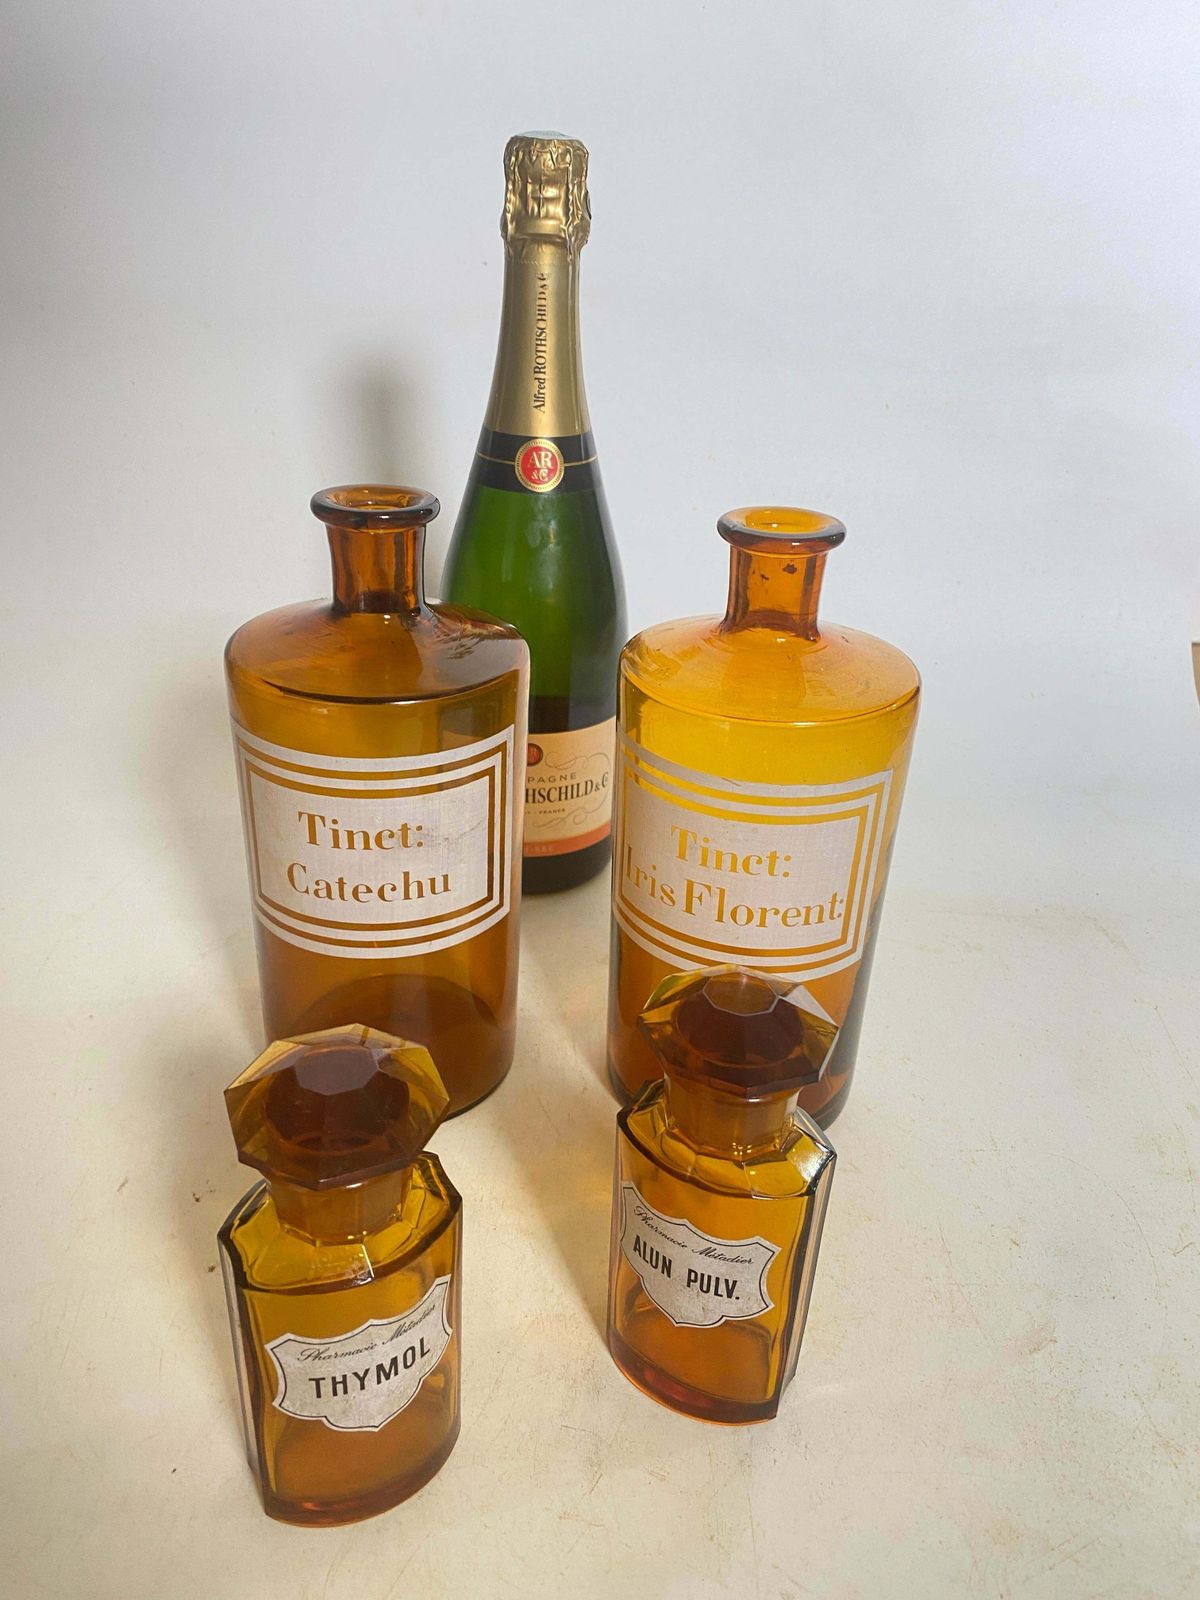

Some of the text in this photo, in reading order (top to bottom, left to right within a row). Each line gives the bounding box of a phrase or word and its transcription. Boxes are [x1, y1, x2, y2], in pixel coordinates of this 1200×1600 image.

[532, 377, 546, 413] Alfred
[528, 451, 553, 469] AR
[297, 810, 423, 850] Tinct:
[670, 824, 792, 878] Tinct:
[287, 862, 451, 903] Catechu
[624, 844, 844, 929] Iris Florent:
[633, 1205, 688, 1249] Pharmacie
[632, 1234, 740, 1300] ALUN PULV.
[297, 1342, 378, 1362] Pharmacie
[308, 1337, 431, 1399] THYMOL
